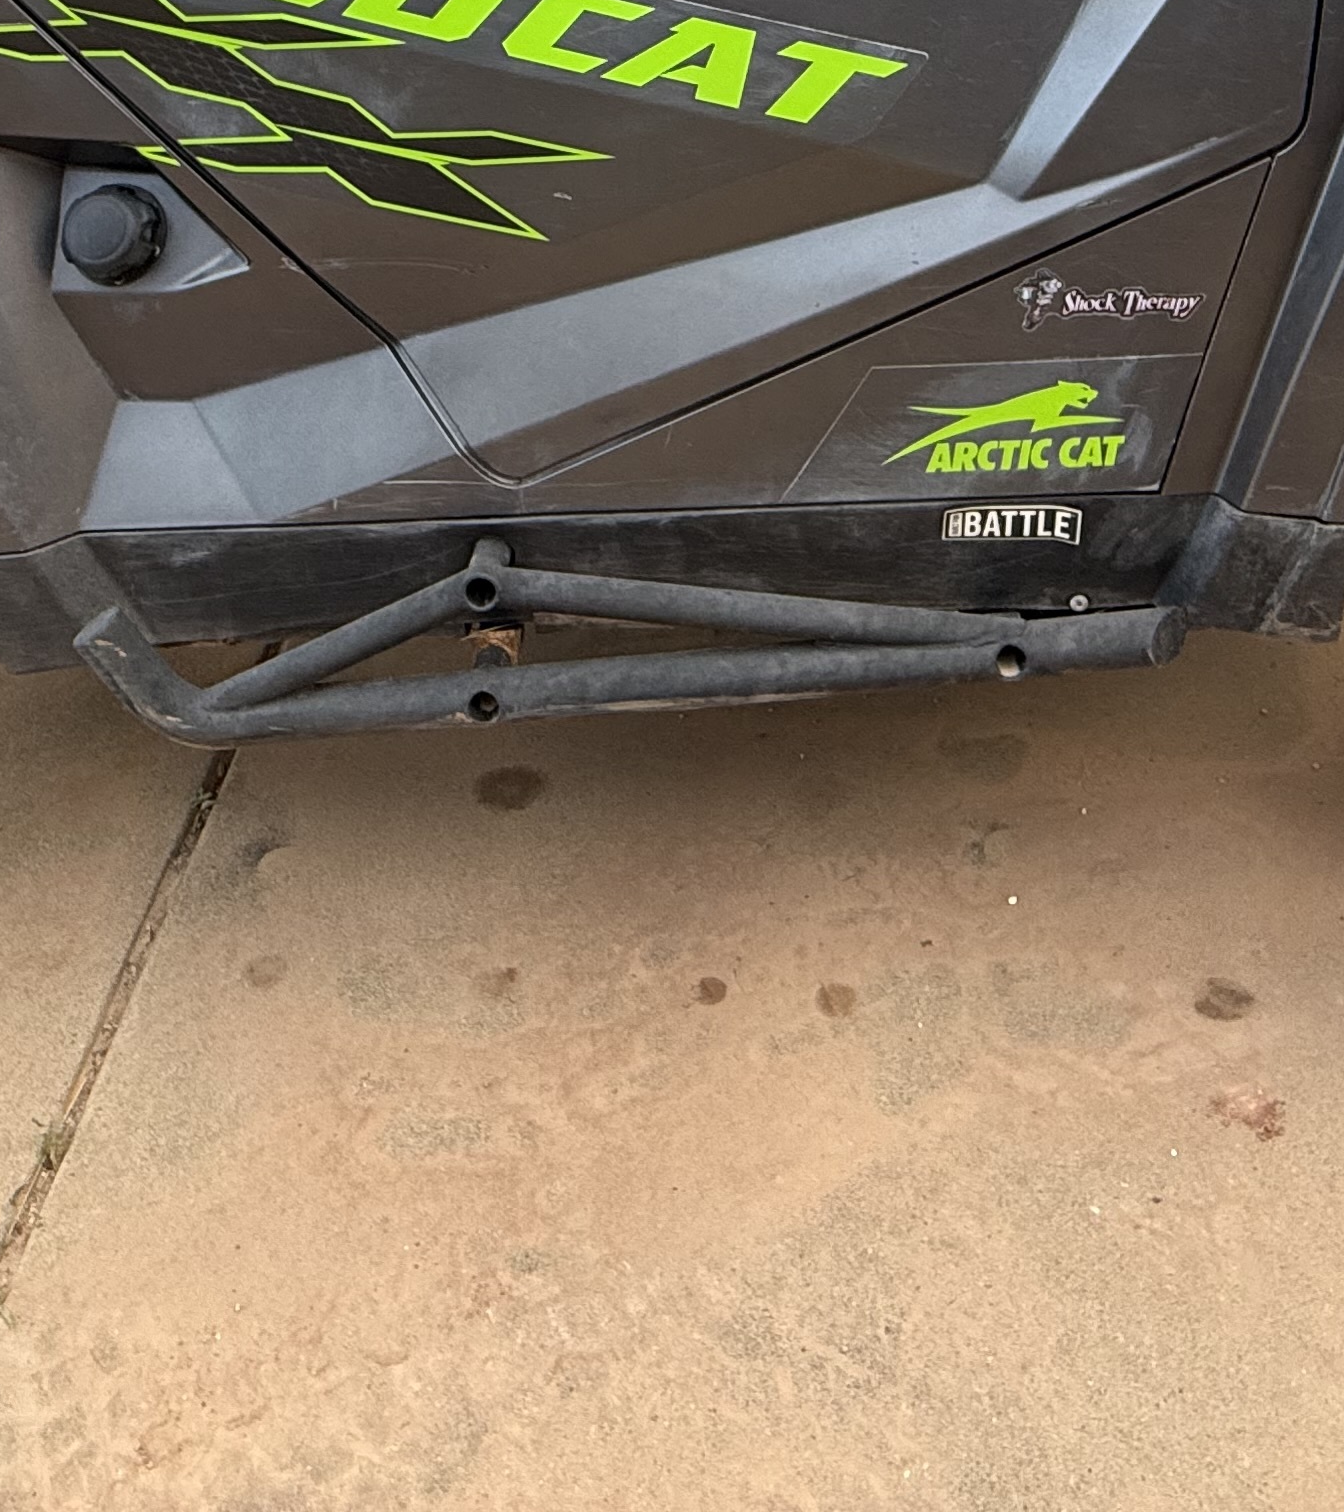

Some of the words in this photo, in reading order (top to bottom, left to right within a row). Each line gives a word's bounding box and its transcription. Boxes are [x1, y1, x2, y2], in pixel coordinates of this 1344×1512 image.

[1061, 289, 1118, 316] Shock
[1122, 290, 1202, 318] Therapy
[924, 438, 1053, 474] ARCTIC
[1058, 435, 1126, 469] CAT
[963, 509, 1073, 540] BATTLE
